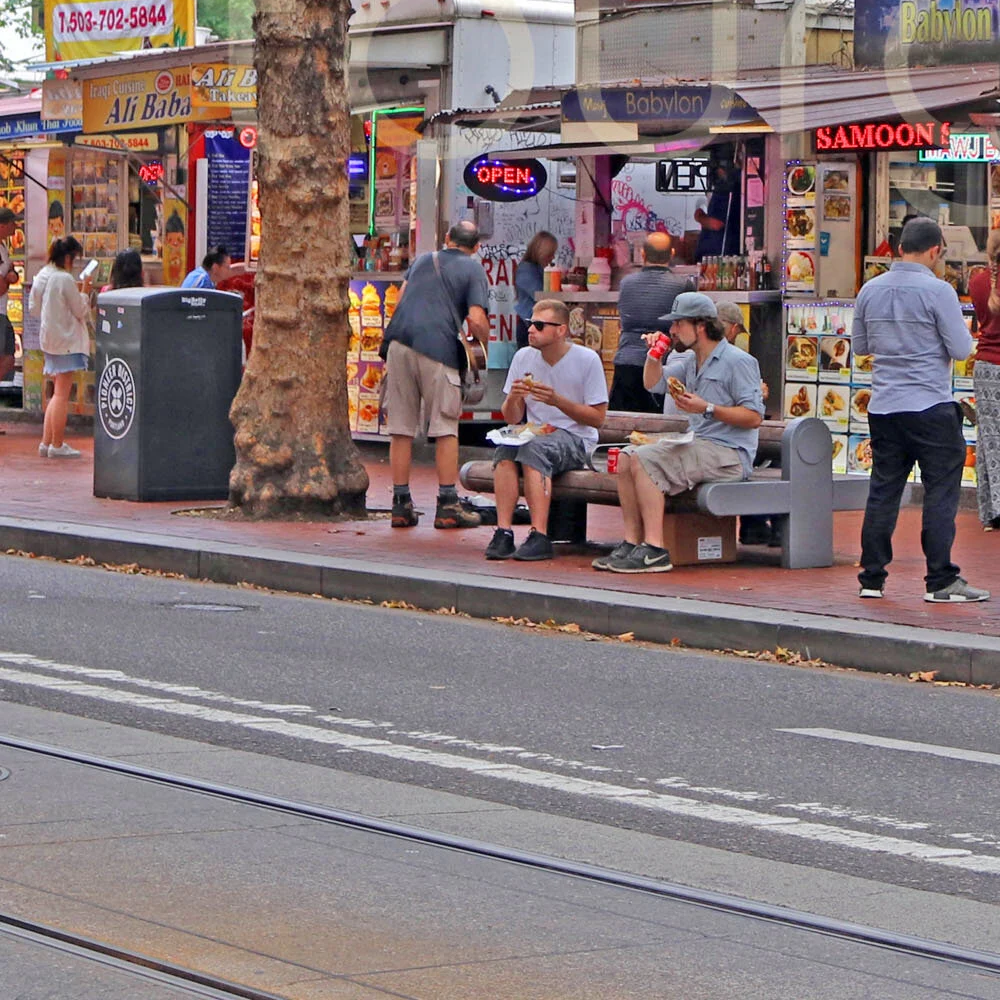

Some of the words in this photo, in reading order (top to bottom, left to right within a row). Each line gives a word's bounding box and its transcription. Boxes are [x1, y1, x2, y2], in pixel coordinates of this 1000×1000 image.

[58, 4, 168, 33] T.503-702-5844
[90, 81, 110, 99] Iraqi
[112, 78, 146, 95] Cuisine
[195, 68, 238, 88] Ali
[104, 95, 139, 126] Ali
[141, 91, 191, 122] Baba
[625, 91, 704, 119] Babylon
[816, 122, 936, 150] SAMOON
[477, 166, 531, 184] OPEN
[100, 363, 117, 410] PIONEER
[118, 363, 134, 414] DISTRICT
